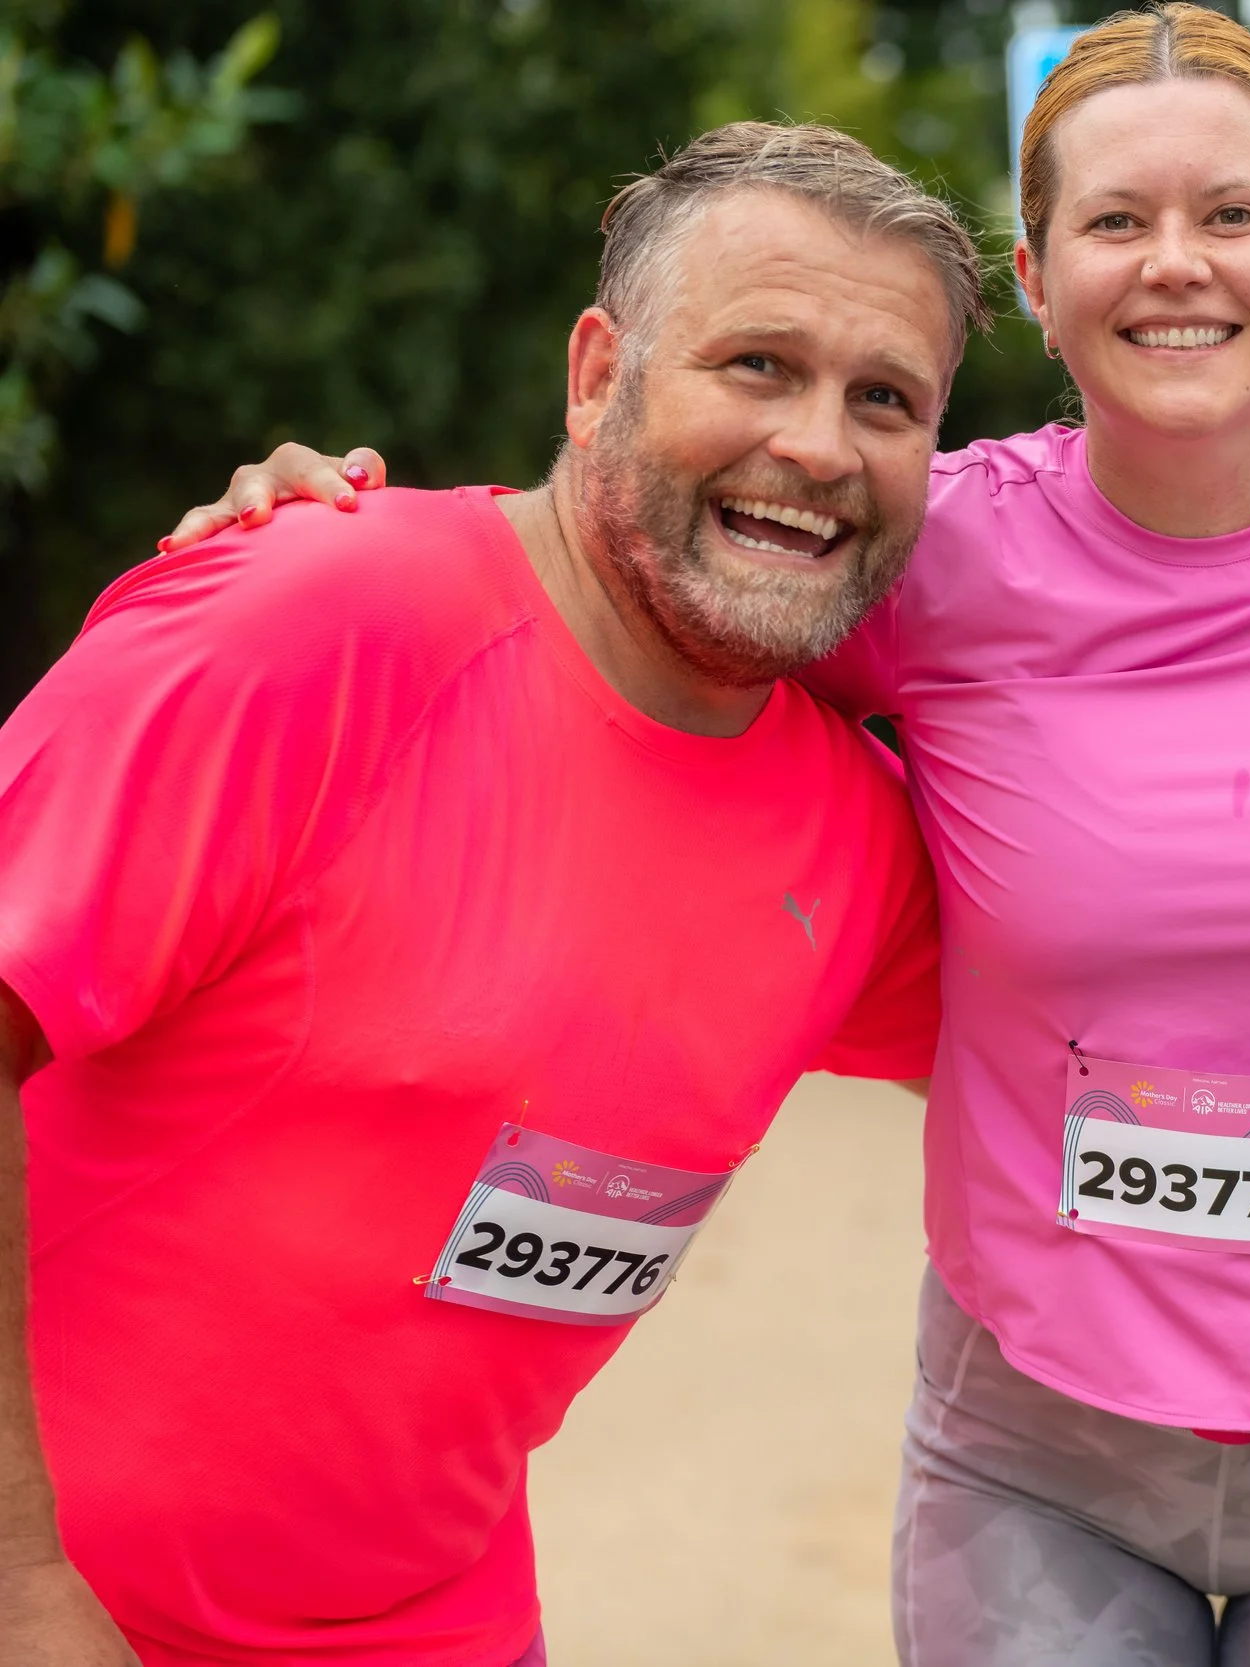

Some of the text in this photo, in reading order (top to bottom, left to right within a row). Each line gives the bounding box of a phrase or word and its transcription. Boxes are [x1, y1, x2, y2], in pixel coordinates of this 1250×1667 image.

[1166, 1094, 1178, 1102] Day
[1192, 1105, 1213, 1115] AIA
[605, 1188, 622, 1198] AIA
[455, 1222, 669, 1295] 293776
